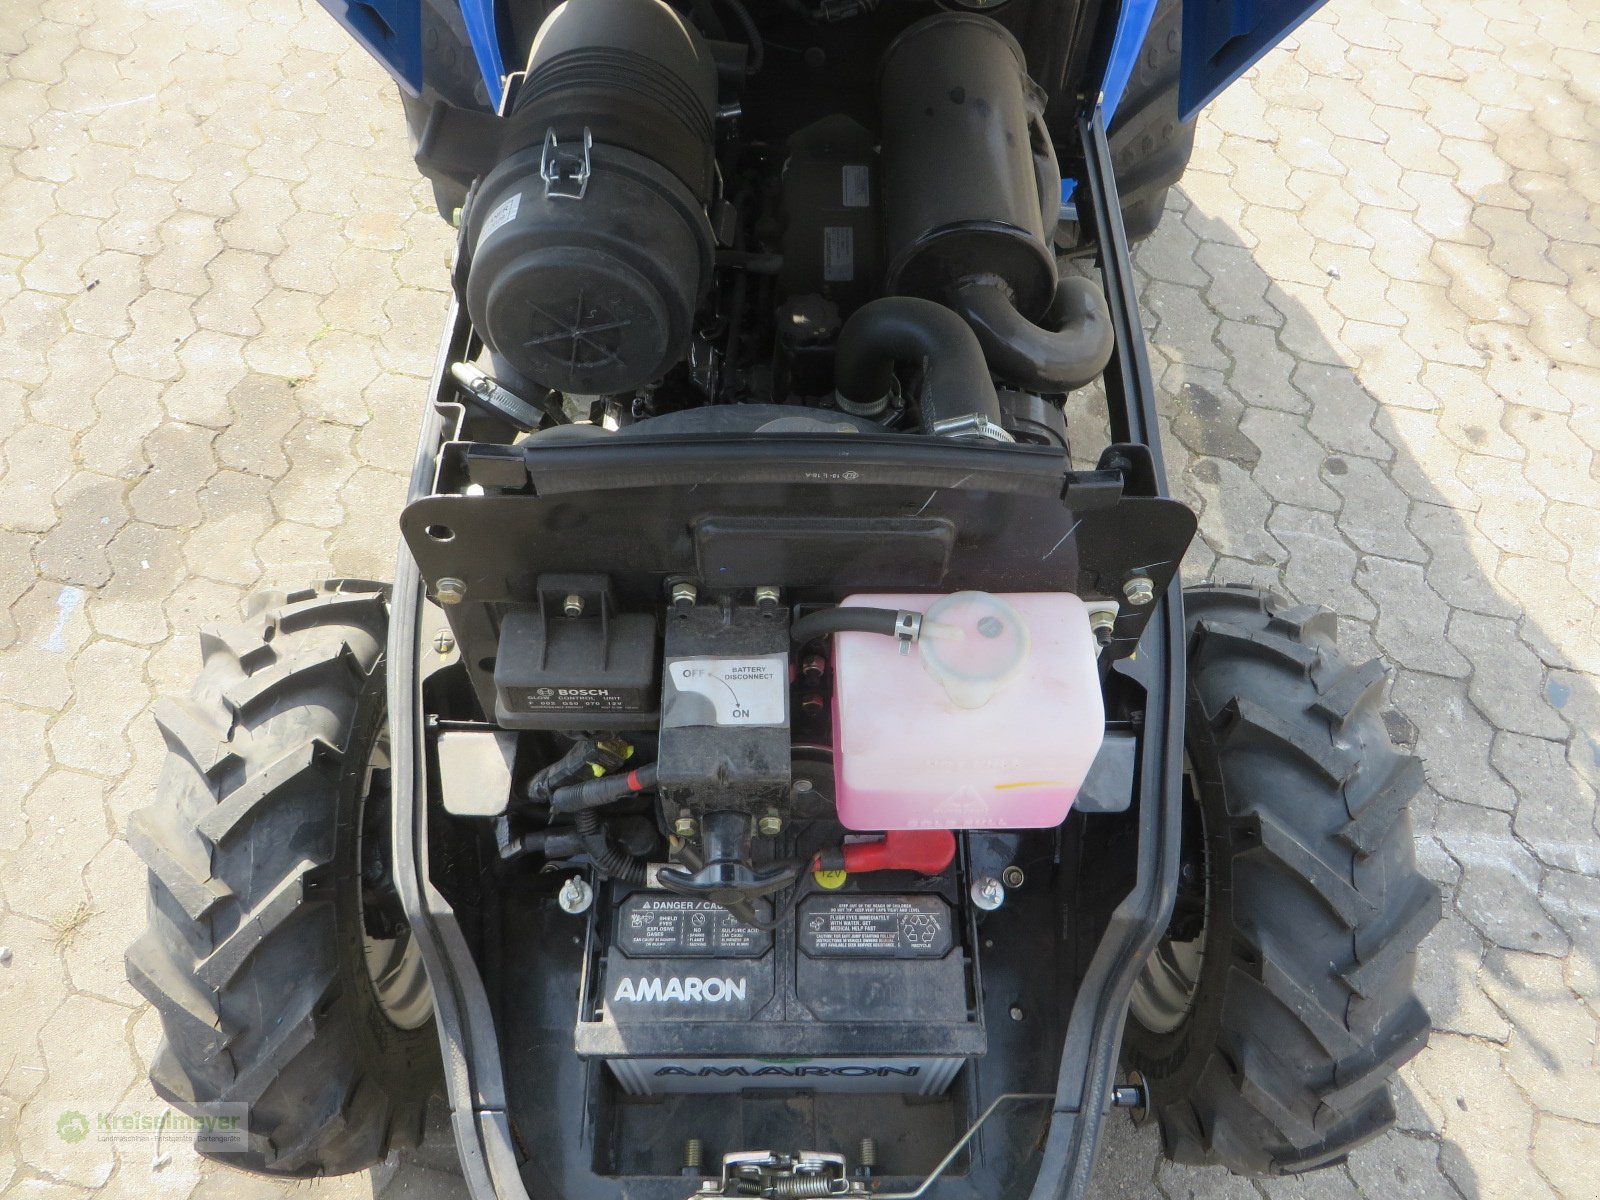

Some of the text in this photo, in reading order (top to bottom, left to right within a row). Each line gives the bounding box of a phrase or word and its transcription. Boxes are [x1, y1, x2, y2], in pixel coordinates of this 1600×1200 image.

[682, 669, 705, 678] OFF
[558, 688, 609, 696] BOSCH
[732, 709, 750, 718] ON
[653, 901, 694, 910] DANGER
[614, 977, 747, 1002] AMARON
[653, 1065, 921, 1077] AMARON
